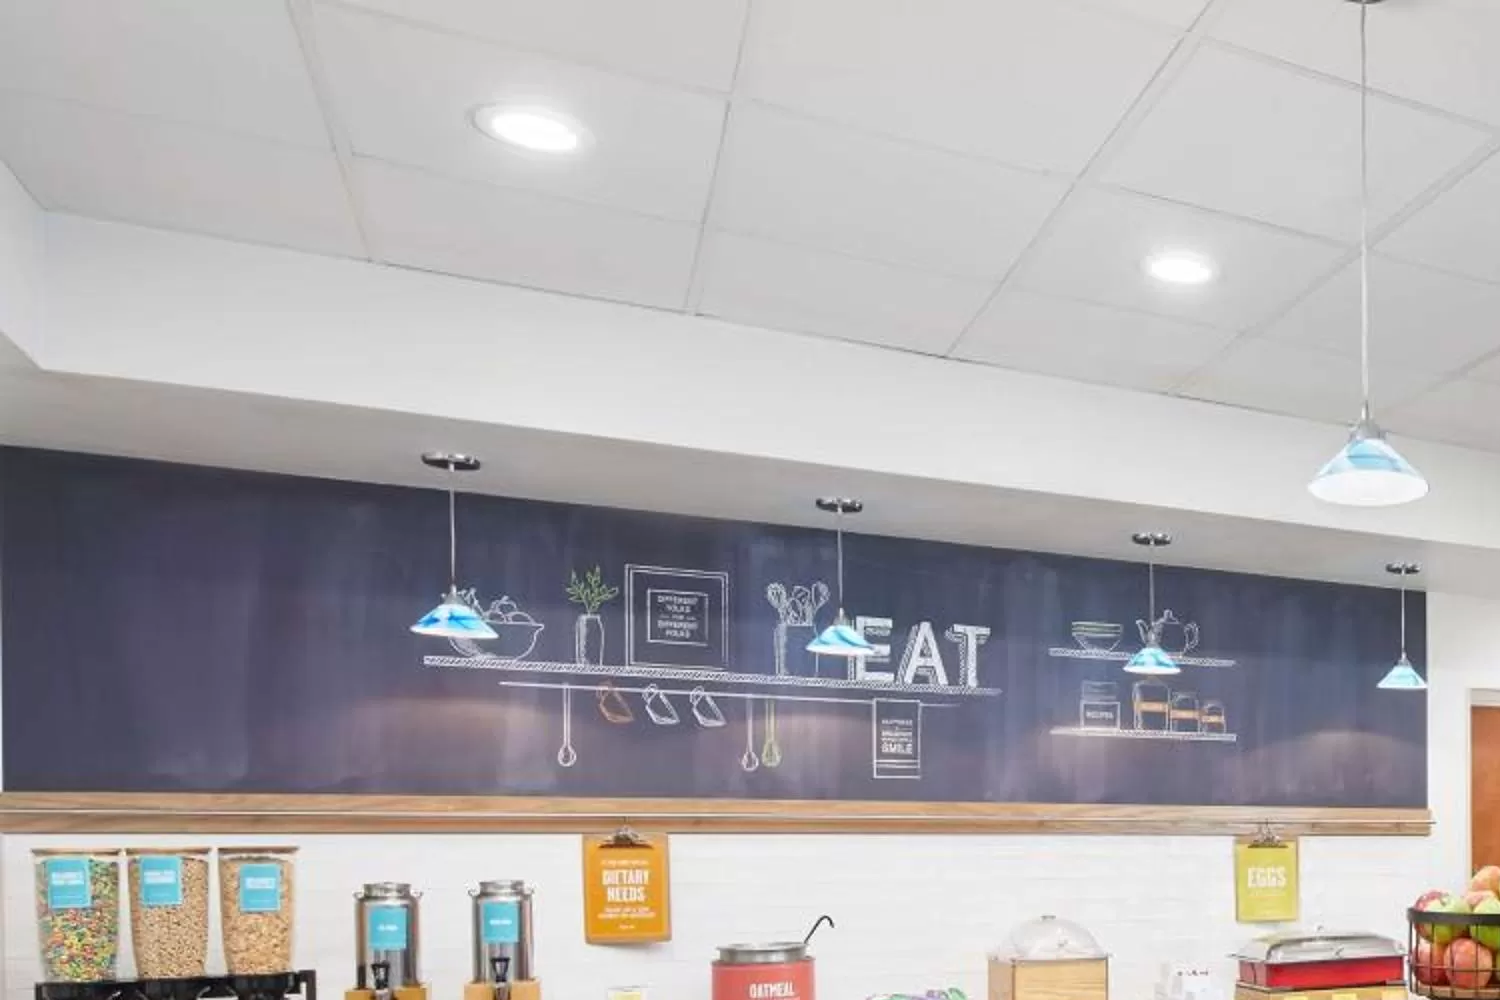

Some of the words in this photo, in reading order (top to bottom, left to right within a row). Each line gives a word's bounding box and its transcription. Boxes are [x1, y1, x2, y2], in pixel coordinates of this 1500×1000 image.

[850, 615, 991, 687] EAT
[602, 868, 649, 885] DIETARY
[1247, 866, 1287, 888] EGGS
[749, 980, 796, 999] OATMEAL
